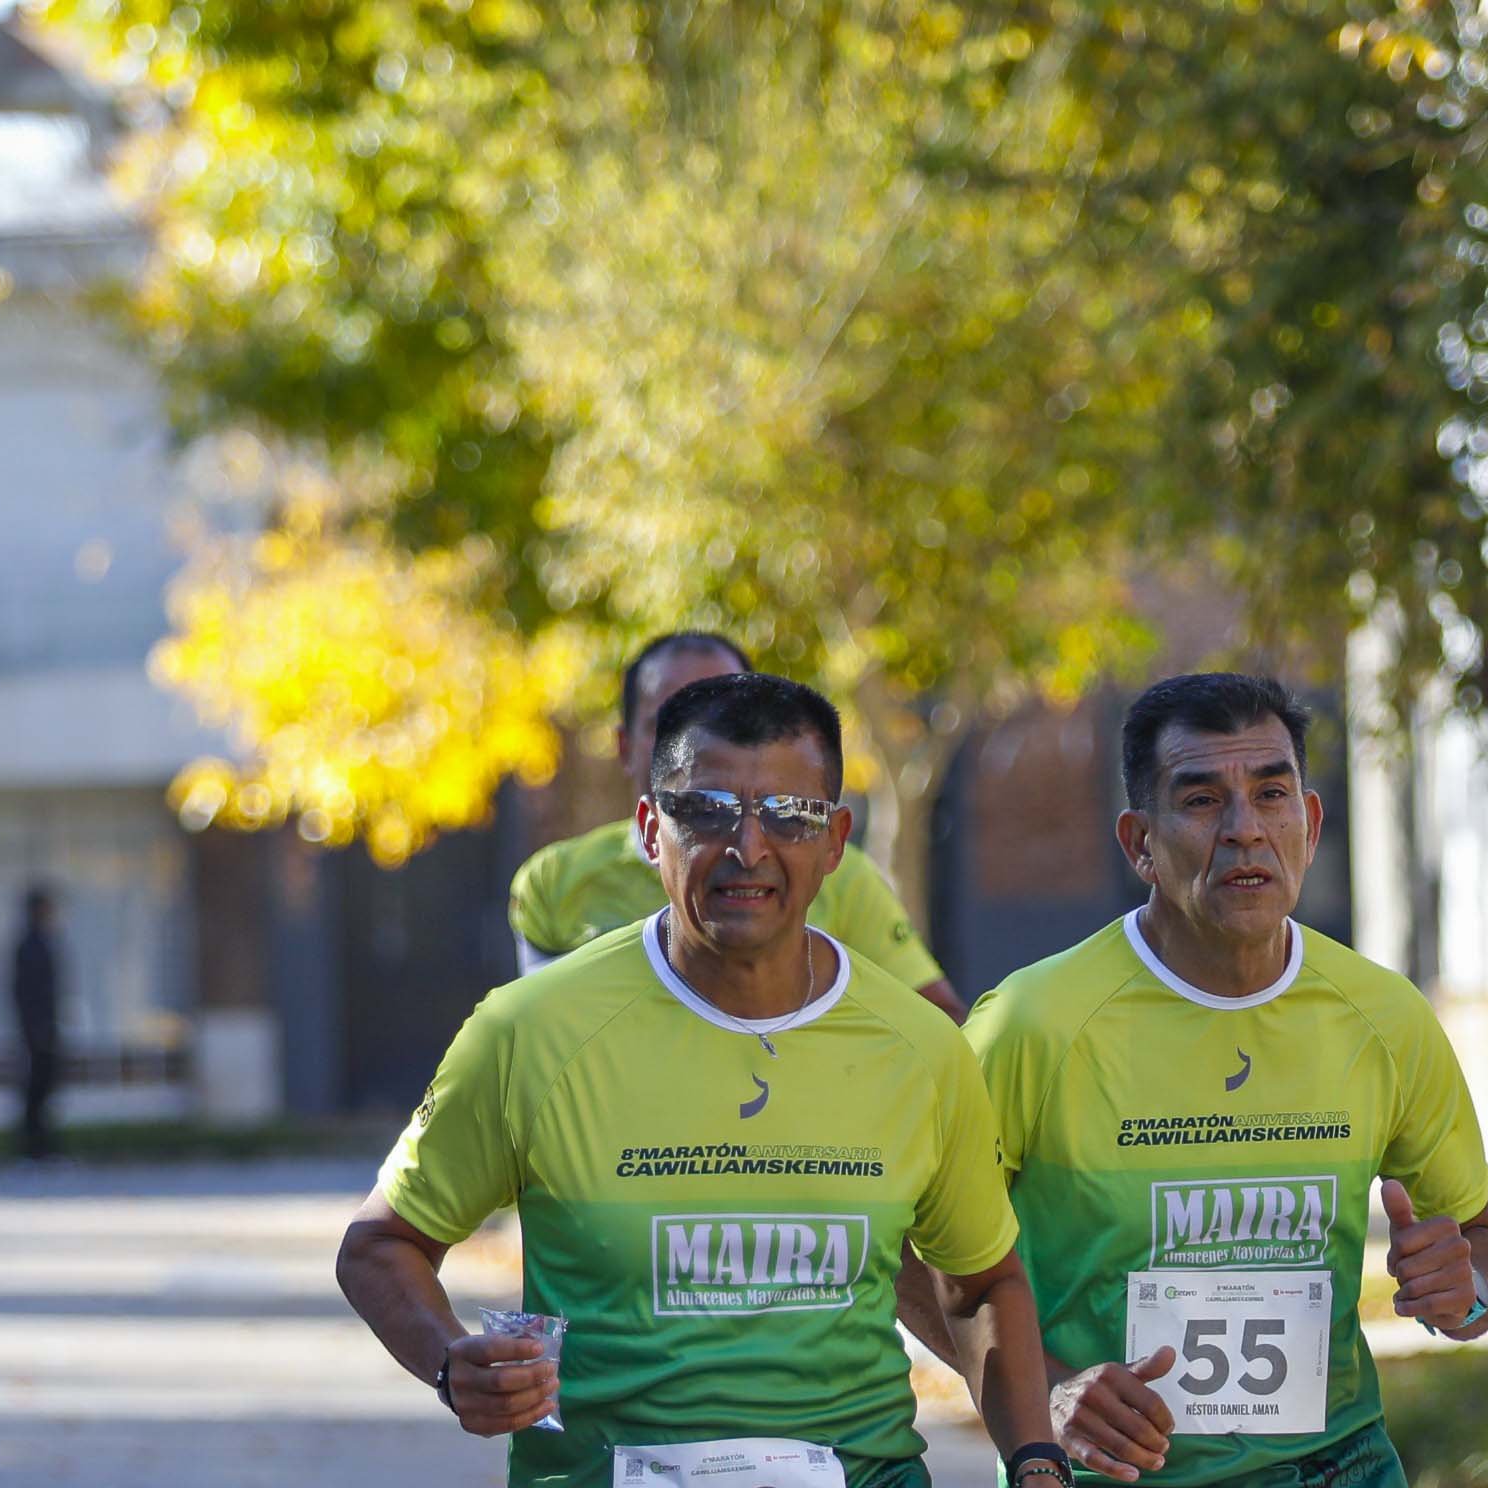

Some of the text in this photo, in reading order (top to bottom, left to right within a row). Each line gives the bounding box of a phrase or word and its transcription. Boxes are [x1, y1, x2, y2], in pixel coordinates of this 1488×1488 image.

[1117, 1124, 1351, 1147] CAWILLIAMSKEMMIS
[616, 1159, 884, 1177] CAWILLIAMSKEMMIS
[1163, 1184, 1323, 1250] MAIRA
[665, 1223, 849, 1285] MAIRA
[666, 1288, 743, 1306] Almacenes
[746, 1286, 817, 1306] Mayoristas
[1177, 1319, 1288, 1396] 55
[1185, 1402, 1280, 1416] NÉSTOR DANIEL AMAYA
